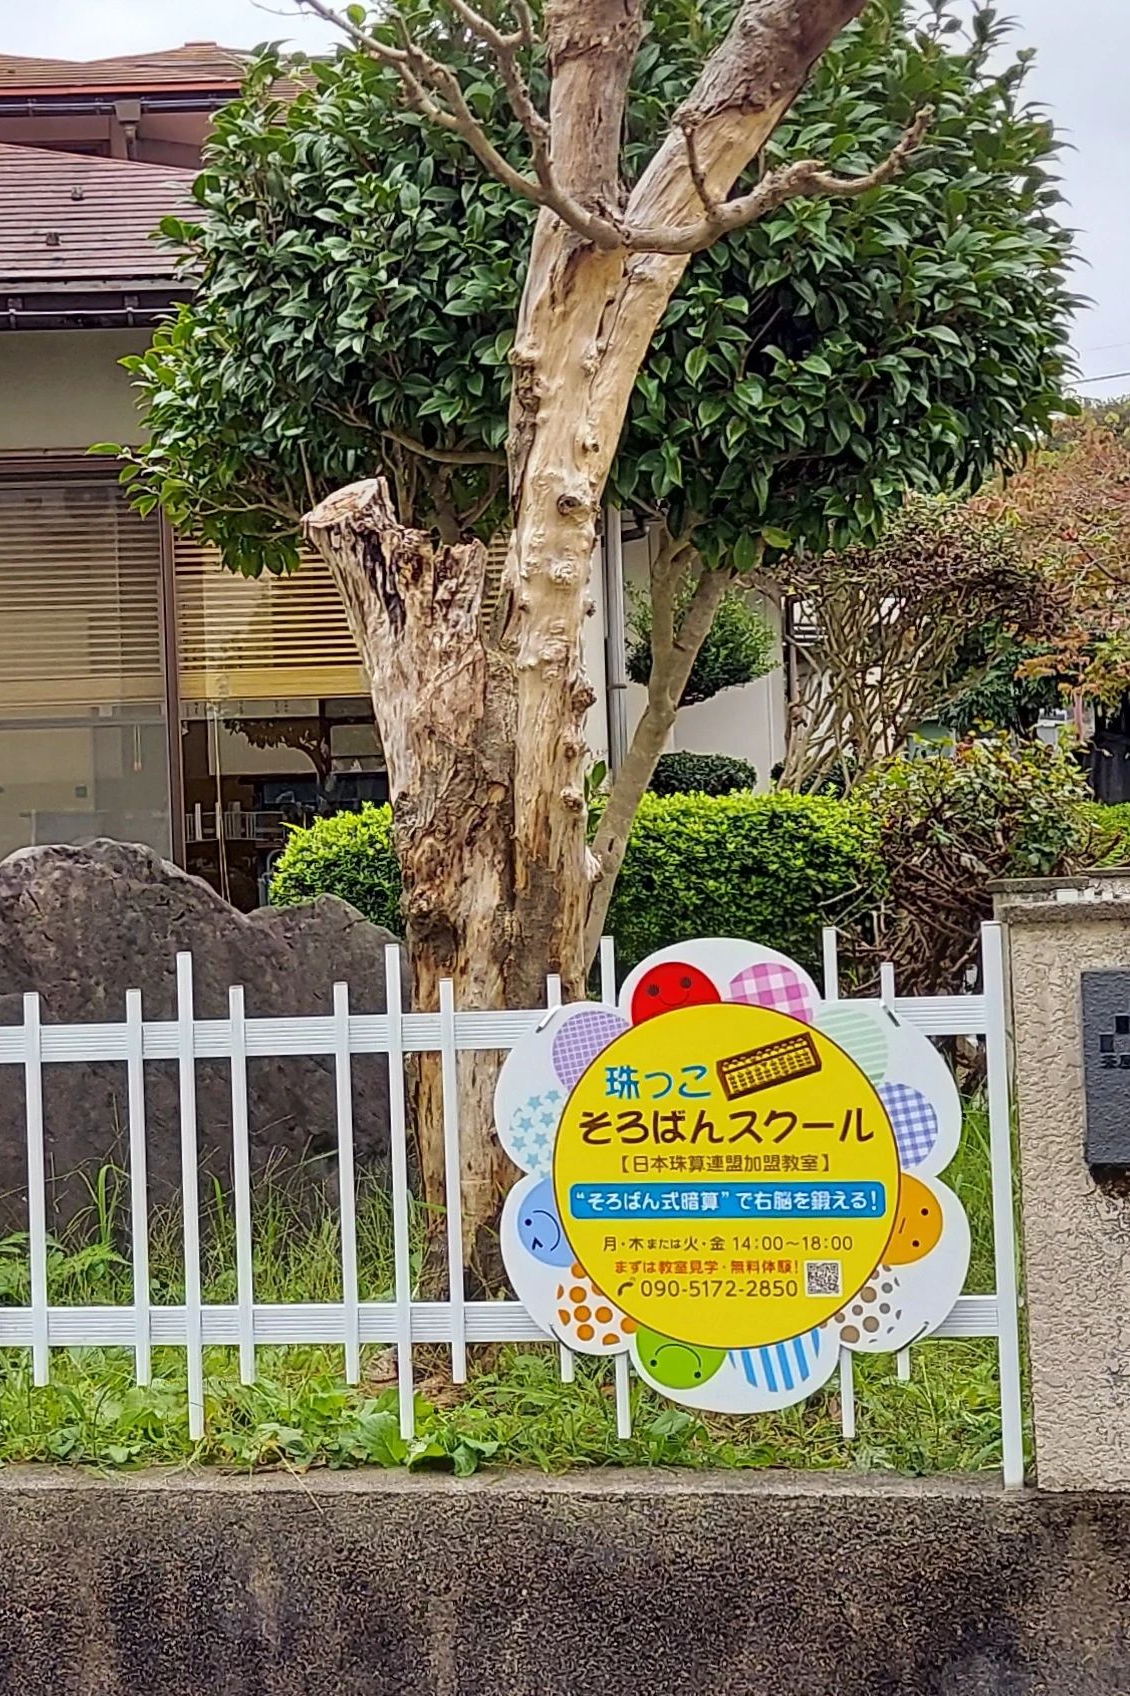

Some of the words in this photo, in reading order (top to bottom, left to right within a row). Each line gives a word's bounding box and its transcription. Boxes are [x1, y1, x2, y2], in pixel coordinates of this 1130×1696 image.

[604, 1065, 711, 1099] 珠っこ
[579, 1107, 875, 1145] そろばんスクール
[620, 1154, 830, 1173] 【日本珠算連盟加盟教室】
[640, 1280, 798, 1298] 090-5172-2850
